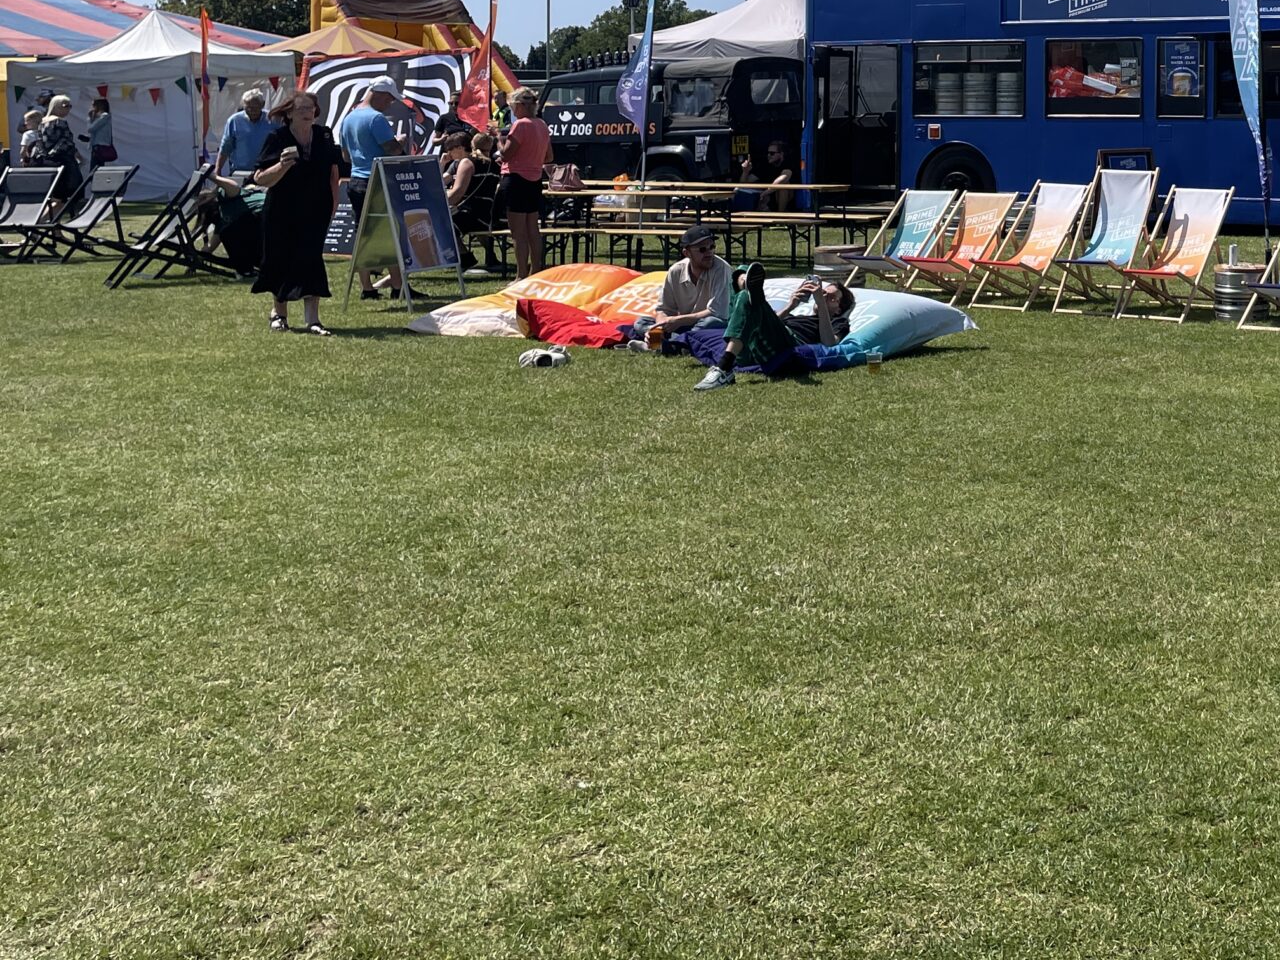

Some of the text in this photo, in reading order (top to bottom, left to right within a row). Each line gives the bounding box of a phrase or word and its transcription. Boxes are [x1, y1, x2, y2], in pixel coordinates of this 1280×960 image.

[570, 124, 593, 136] DOG
[595, 122, 656, 136] COCKTAS
[396, 172, 414, 180] GRAB
[400, 183, 420, 191] COLD
[405, 193, 421, 201] ONE
[906, 209, 934, 223] PRIME
[966, 212, 996, 226] PRIME
[917, 221, 937, 231] TIM
[978, 224, 997, 234] TIM
